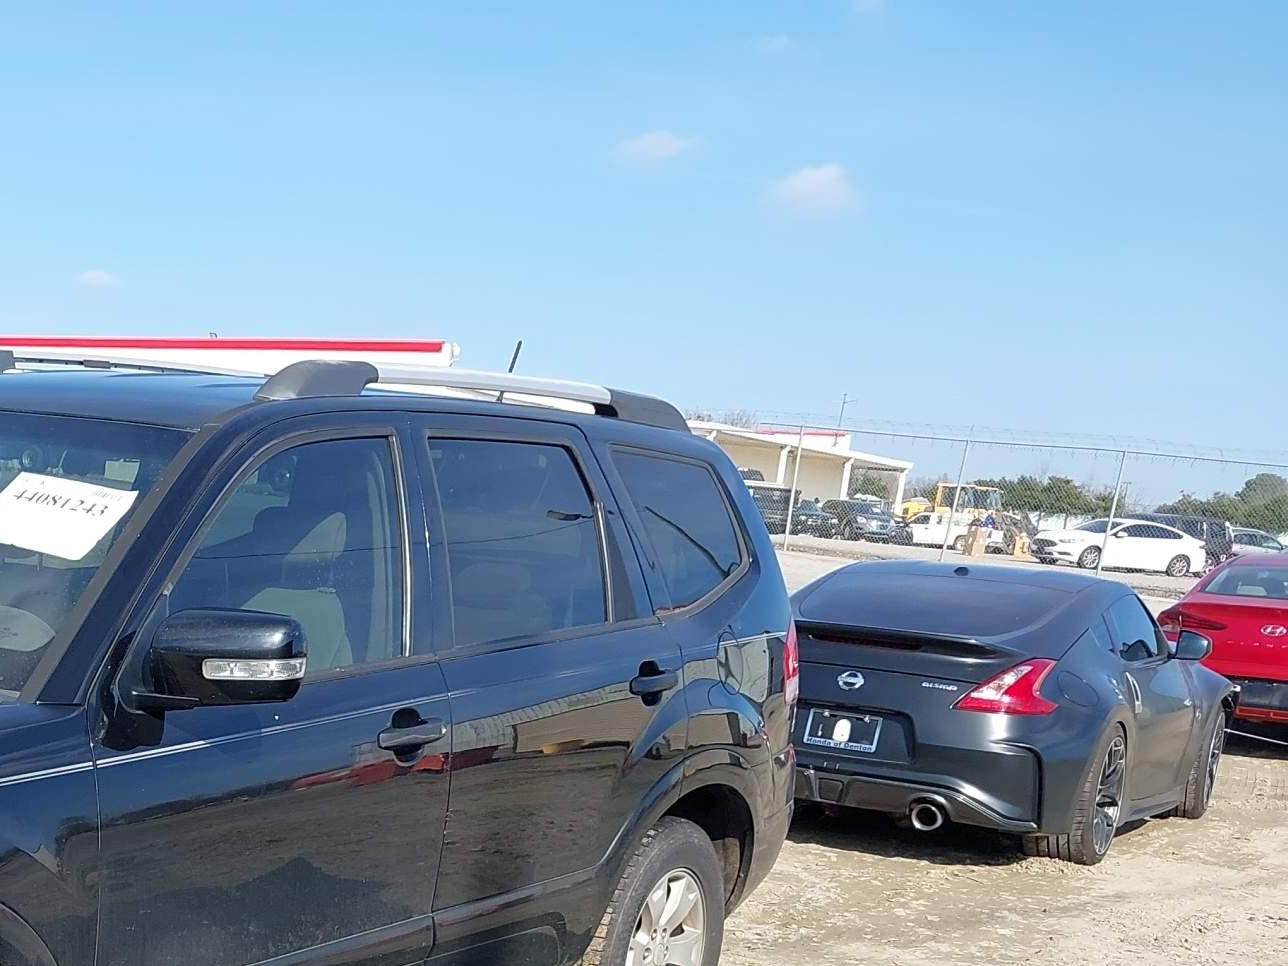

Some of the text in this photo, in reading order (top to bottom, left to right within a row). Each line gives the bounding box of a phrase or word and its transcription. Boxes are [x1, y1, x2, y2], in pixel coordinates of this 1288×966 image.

[13, 489, 108, 516] 44081243
[806, 736, 873, 752] Honda of Denton
